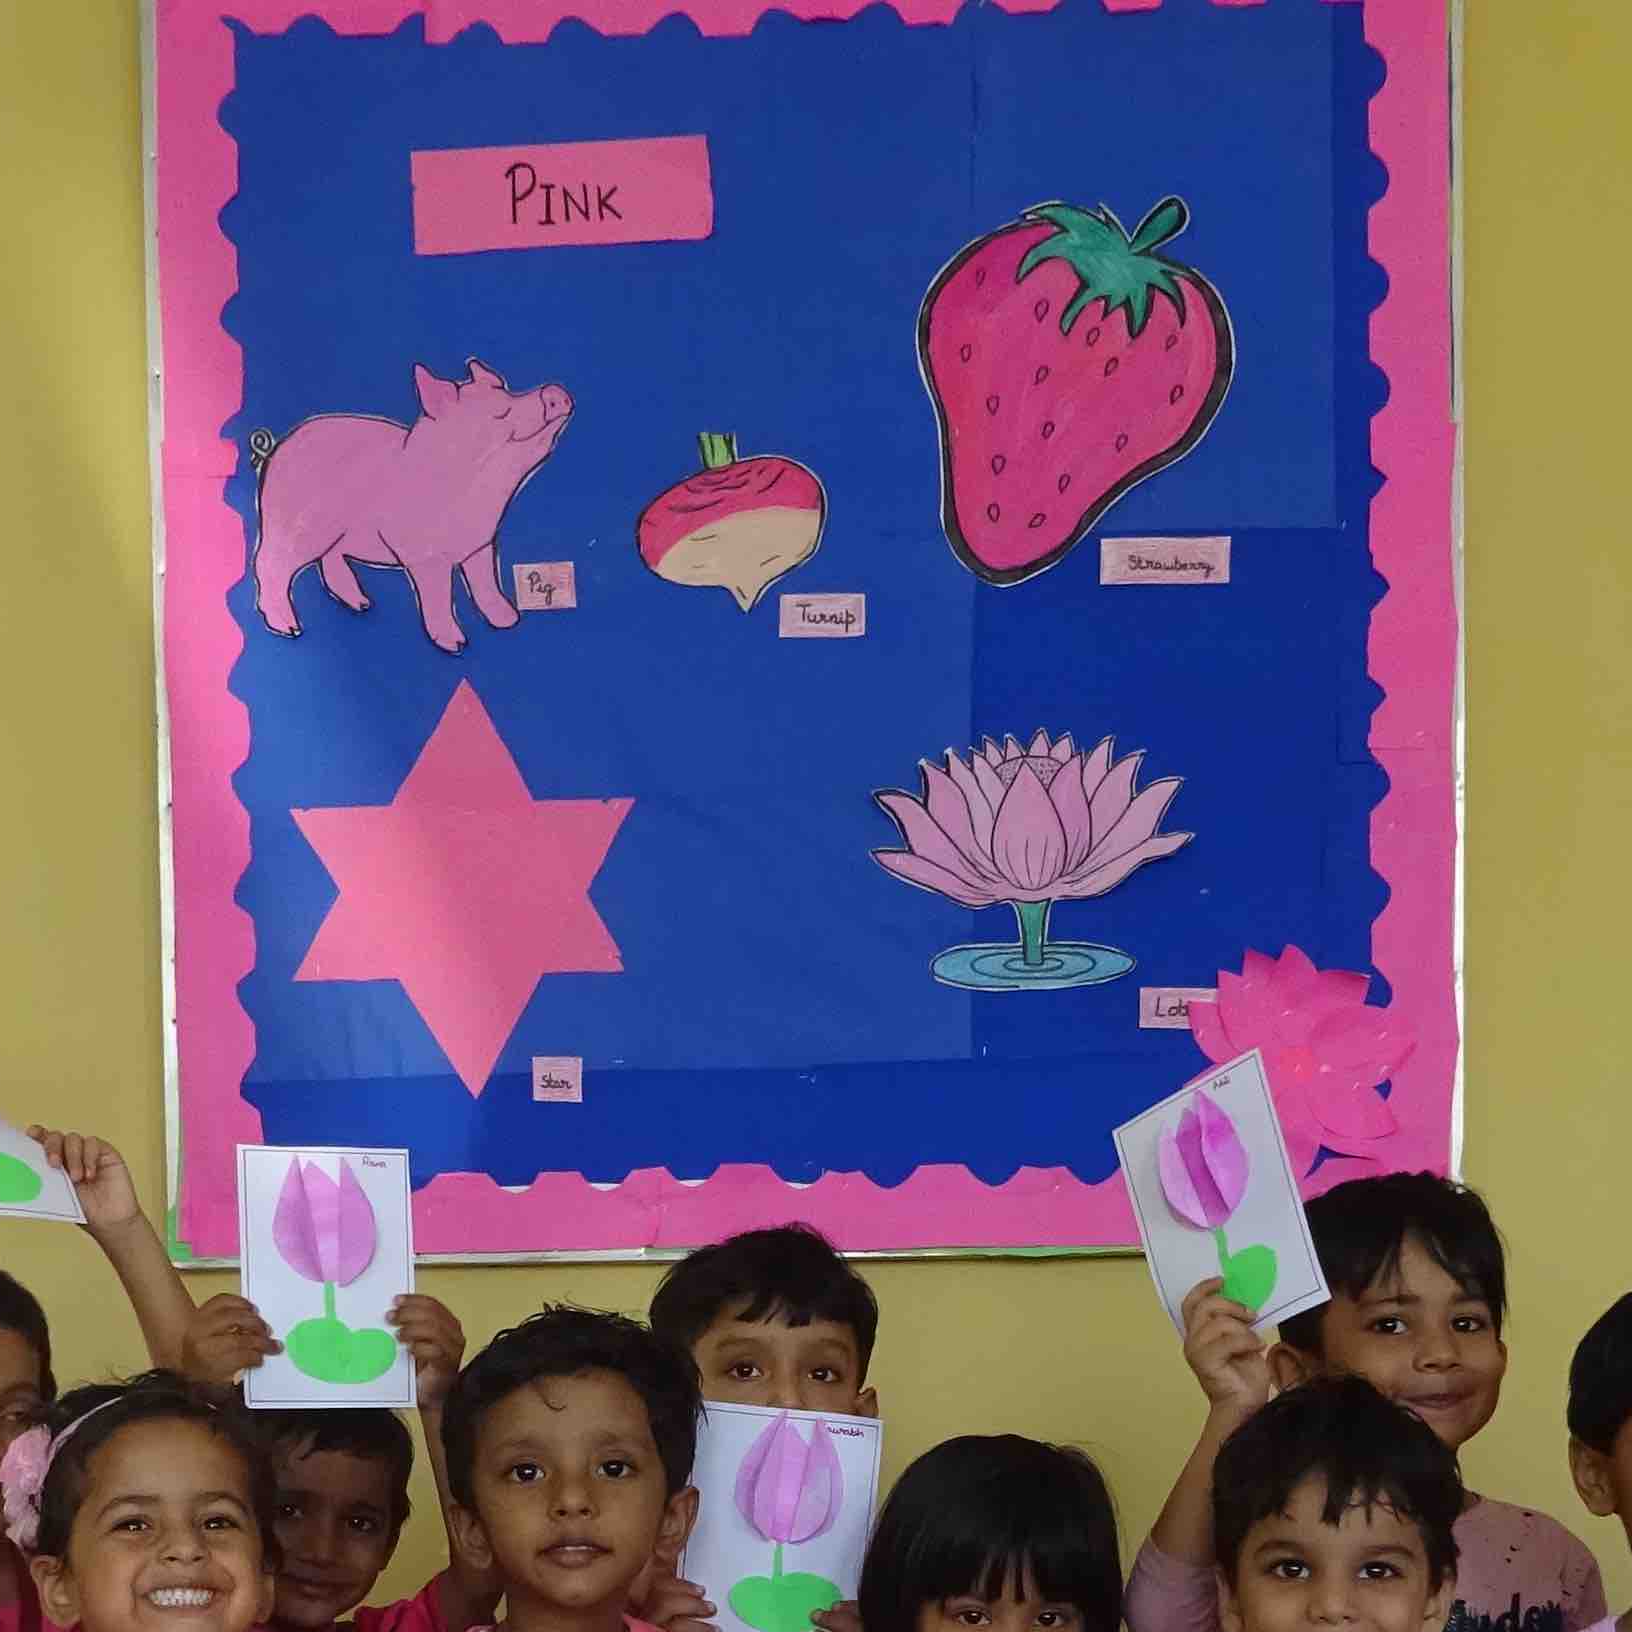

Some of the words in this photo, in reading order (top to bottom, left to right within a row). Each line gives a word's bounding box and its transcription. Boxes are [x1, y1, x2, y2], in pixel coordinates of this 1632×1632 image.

[505, 162, 623, 224] PINK
[528, 572, 556, 605] Pig
[794, 603, 856, 632] Turnip
[1155, 997, 1190, 1018] Lot
[541, 1072, 572, 1089] Star
